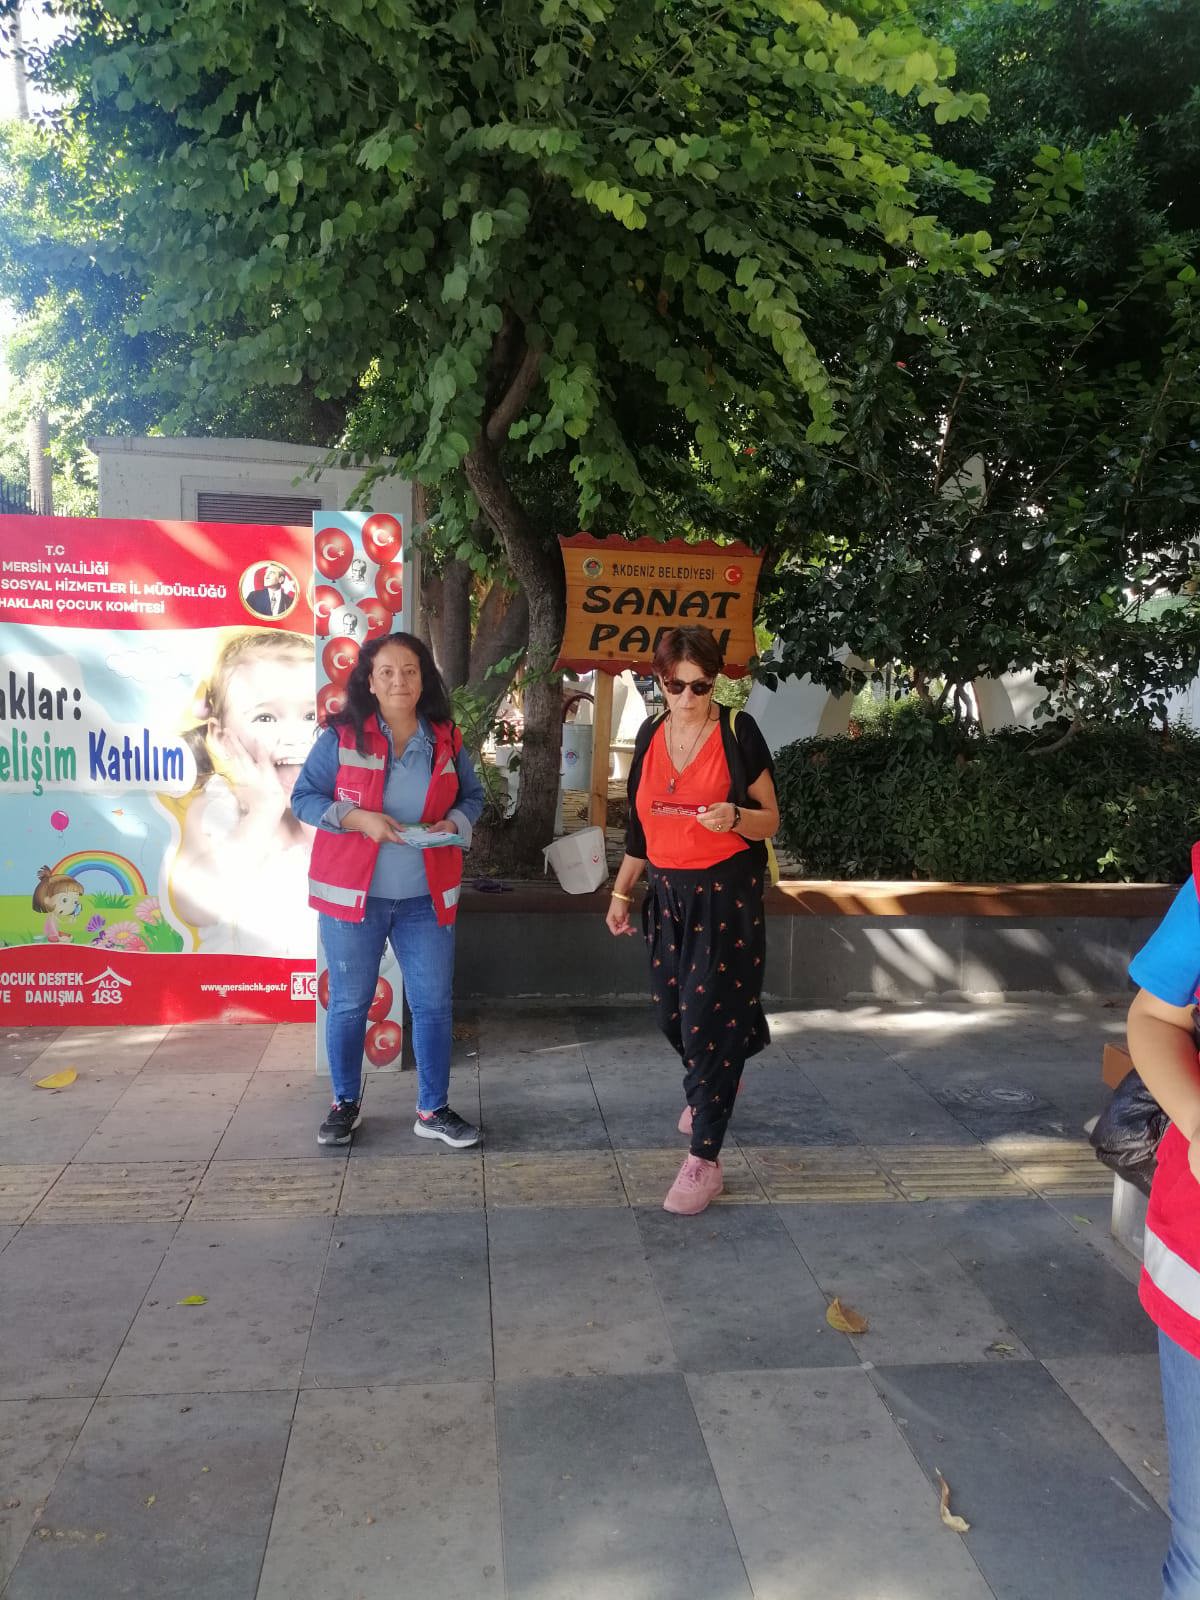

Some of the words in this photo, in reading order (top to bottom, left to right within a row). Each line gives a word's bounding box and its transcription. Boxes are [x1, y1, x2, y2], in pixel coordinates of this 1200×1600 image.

[2, 559, 51, 573] MERSİN
[54, 560, 109, 575] VALİLİĞİ
[612, 563, 655, 578] AKDENİZ
[658, 565, 715, 580] BELEDİYESİ
[1, 579, 53, 592] SOSYAL
[55, 577, 127, 594] HİZMETLER
[129, 580, 141, 595] İL
[143, 581, 227, 598] MÜDÜRLÜĞÜ
[56, 599, 103, 612] ÇOCUK
[106, 599, 165, 614] KOMİTESİ
[582, 585, 741, 619] SANAT
[89, 728, 184, 782] Katılım
[0, 972, 36, 986] OCUK
[38, 972, 84, 986] DESTEK
[98, 979, 120, 989] ALO
[200, 982, 288, 993] www.mersinchk.gov.tr
[25, 990, 84, 1007] DANIŞMA
[91, 989, 123, 1005] 183
